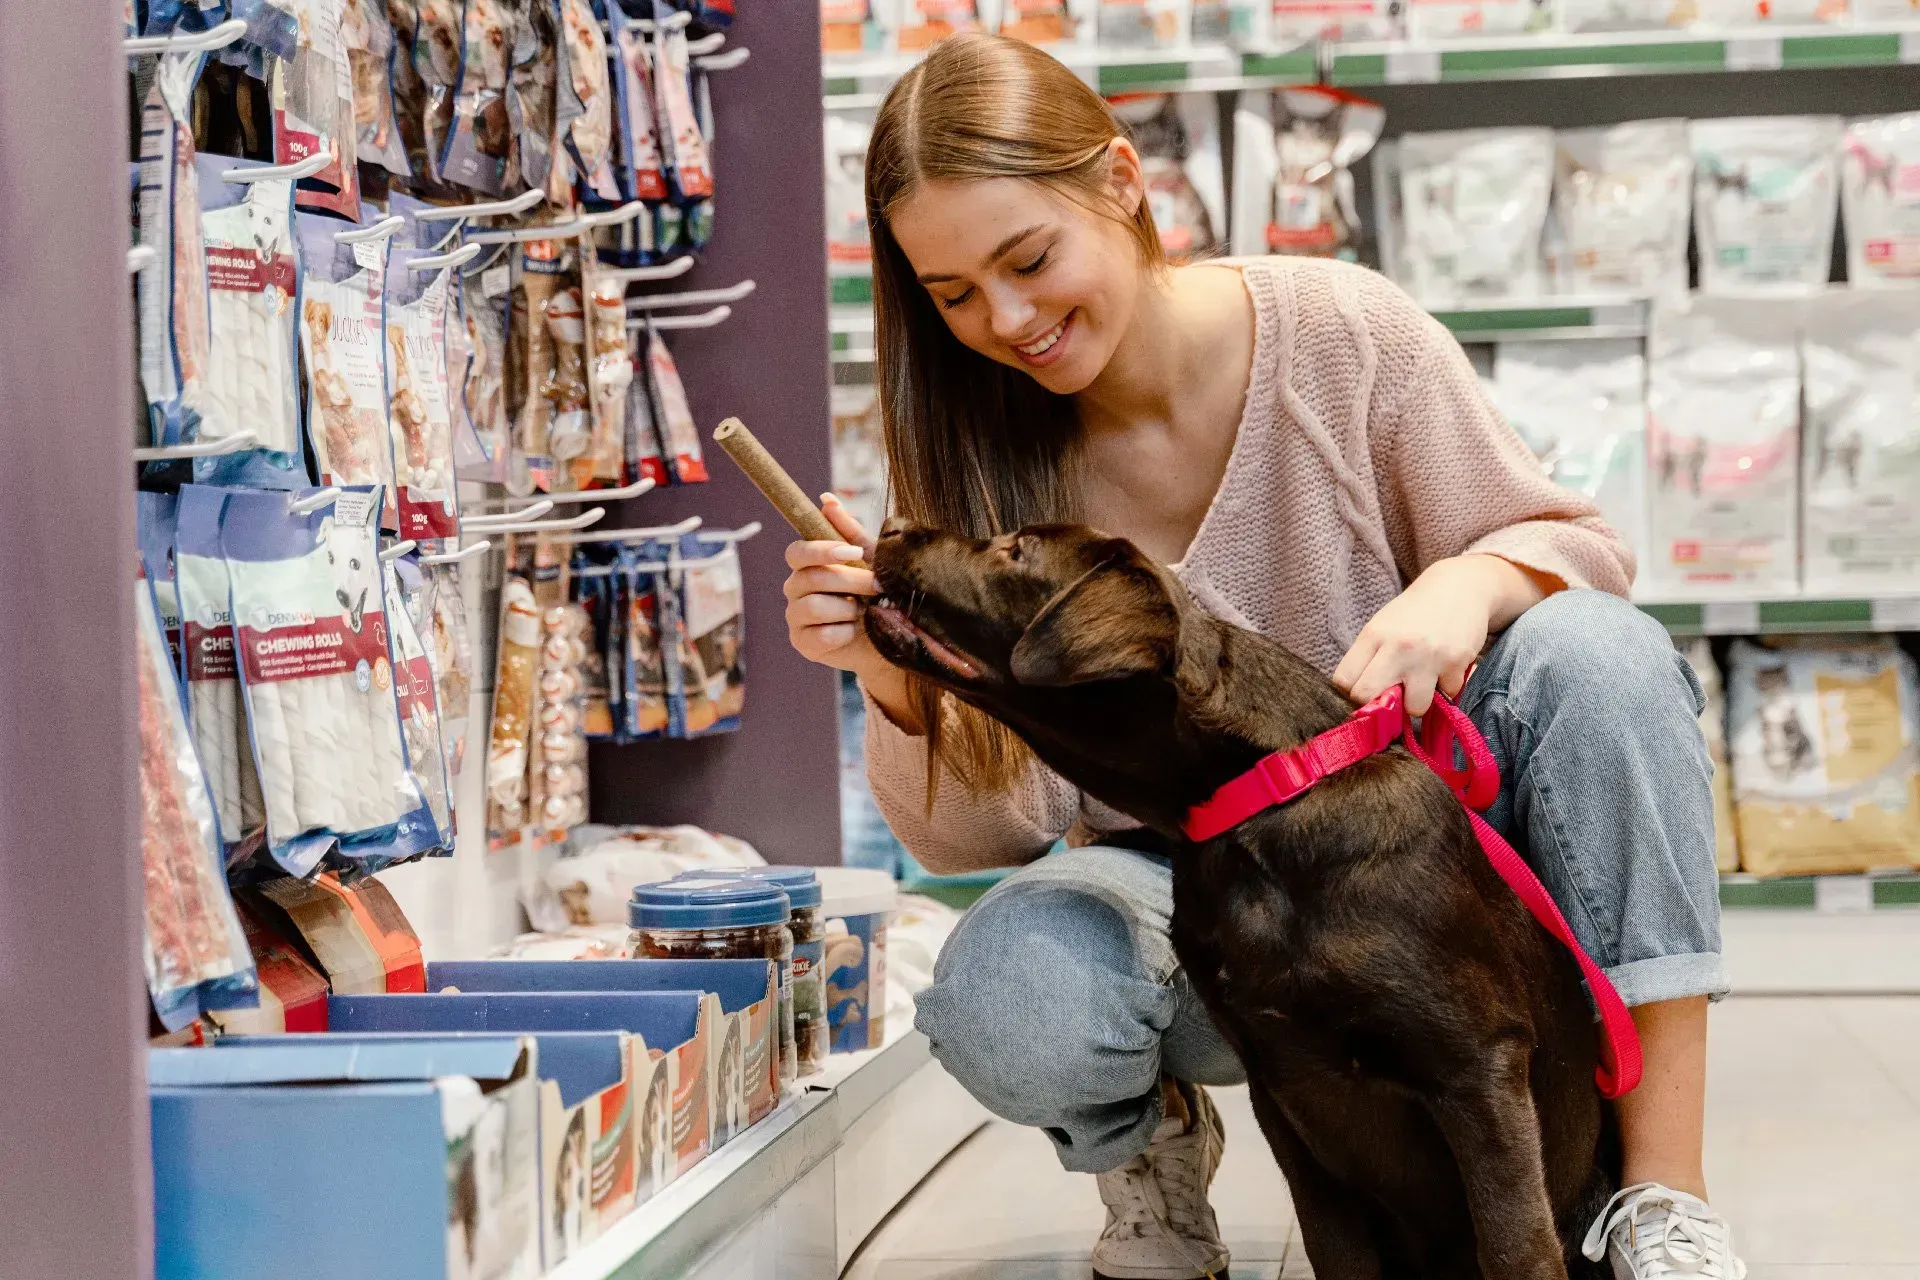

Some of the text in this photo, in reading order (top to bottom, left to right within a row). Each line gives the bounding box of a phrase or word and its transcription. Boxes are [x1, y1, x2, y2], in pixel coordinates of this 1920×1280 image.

[232, 258, 257, 270] ROLLS
[255, 632, 344, 654] CHEWING ROLLS
[396, 684, 409, 698] OLLS
[397, 823, 410, 835] 15
[792, 960, 811, 973] RIXIE
